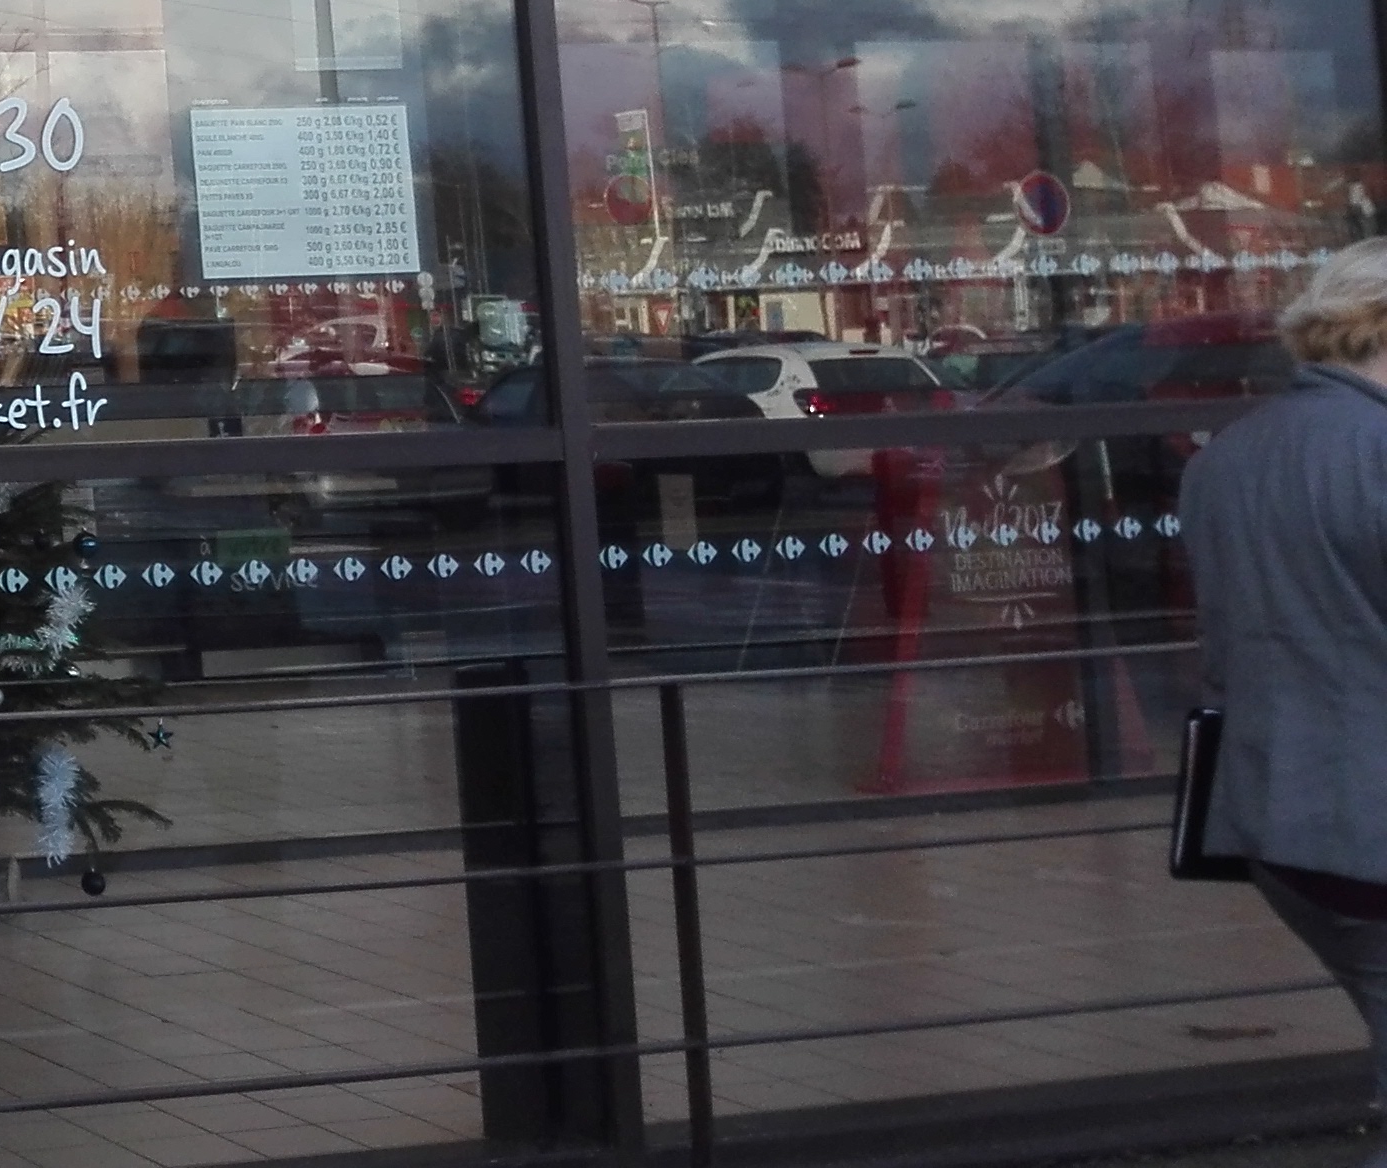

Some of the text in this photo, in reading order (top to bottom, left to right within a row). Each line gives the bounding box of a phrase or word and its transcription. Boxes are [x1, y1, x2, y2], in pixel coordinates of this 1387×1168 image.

[32, 296, 103, 359] 24
[954, 547, 1064, 572] DESTINATION
[950, 566, 1074, 592] IMAGINATION
